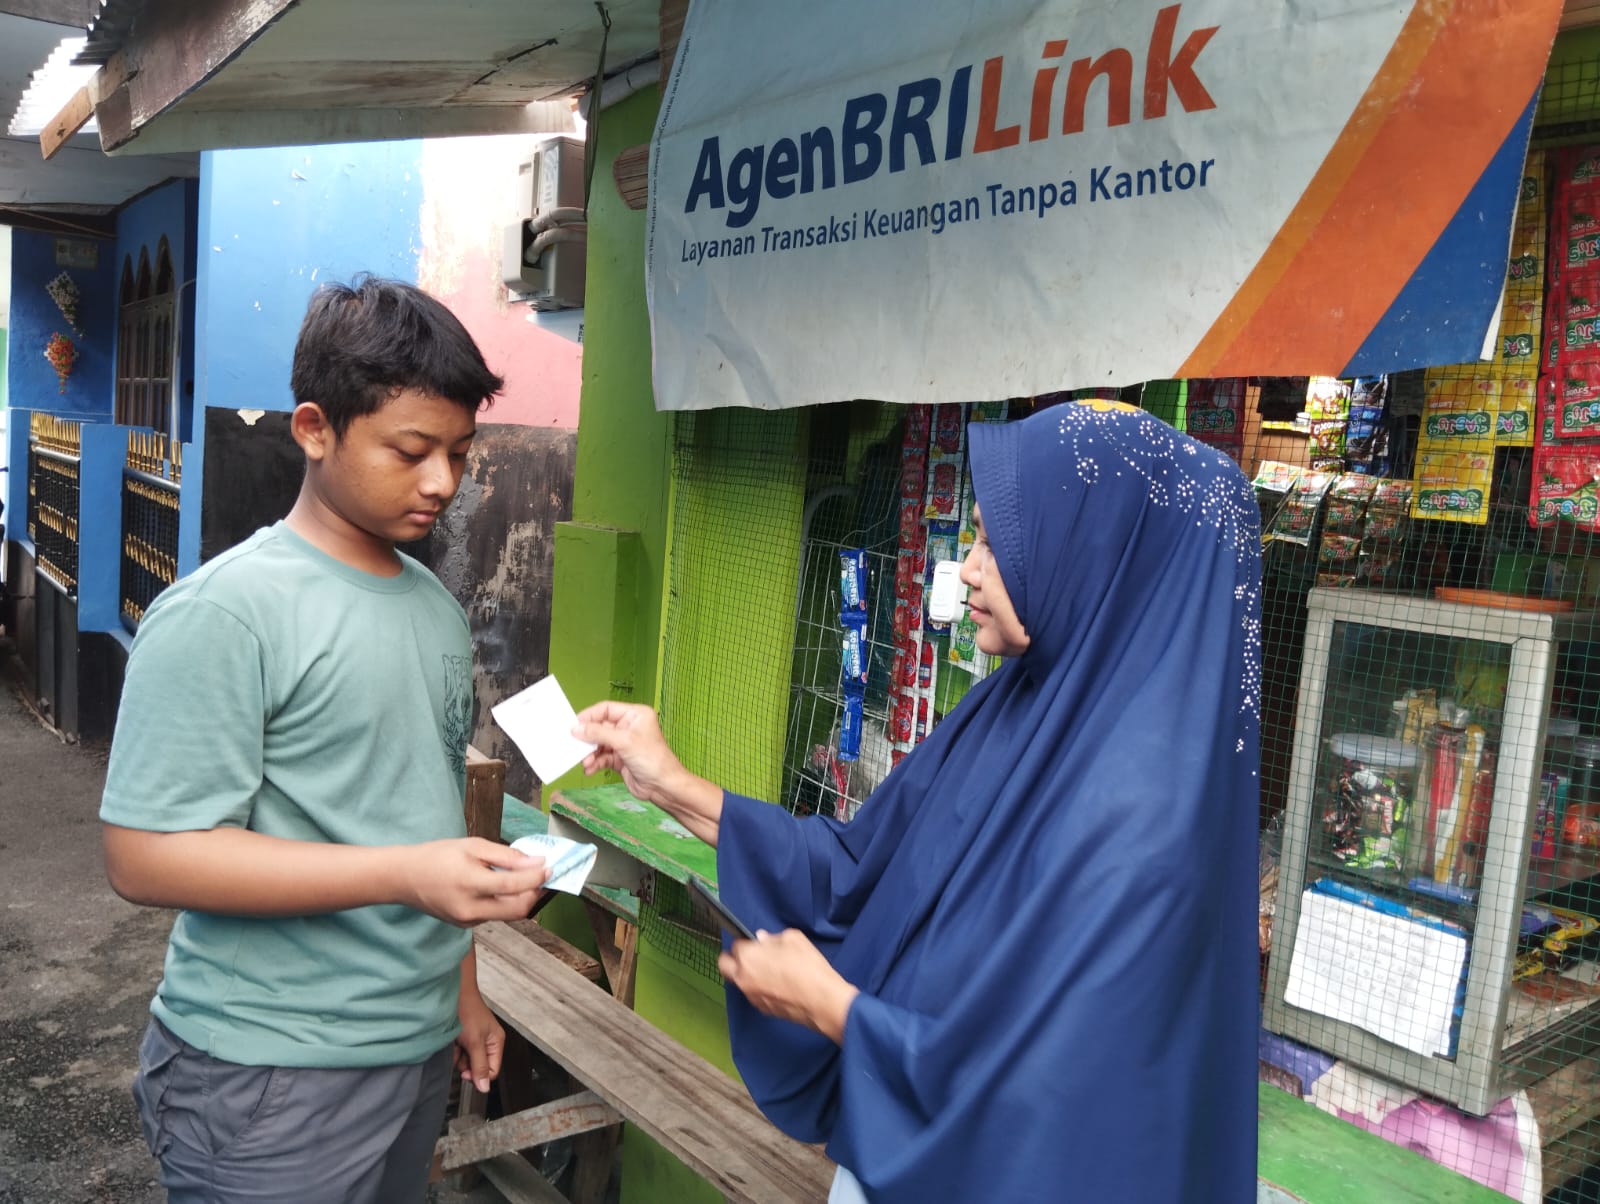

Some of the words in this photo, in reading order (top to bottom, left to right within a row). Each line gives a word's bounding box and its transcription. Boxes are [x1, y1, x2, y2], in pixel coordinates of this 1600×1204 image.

[684, 3, 1221, 228] AgenBRILink
[682, 233, 755, 266] Layanan
[762, 212, 857, 253] Transaksi
[863, 197, 980, 234] Keuangan
[987, 173, 1077, 218] Tanpa
[1090, 158, 1215, 201] Kantor
